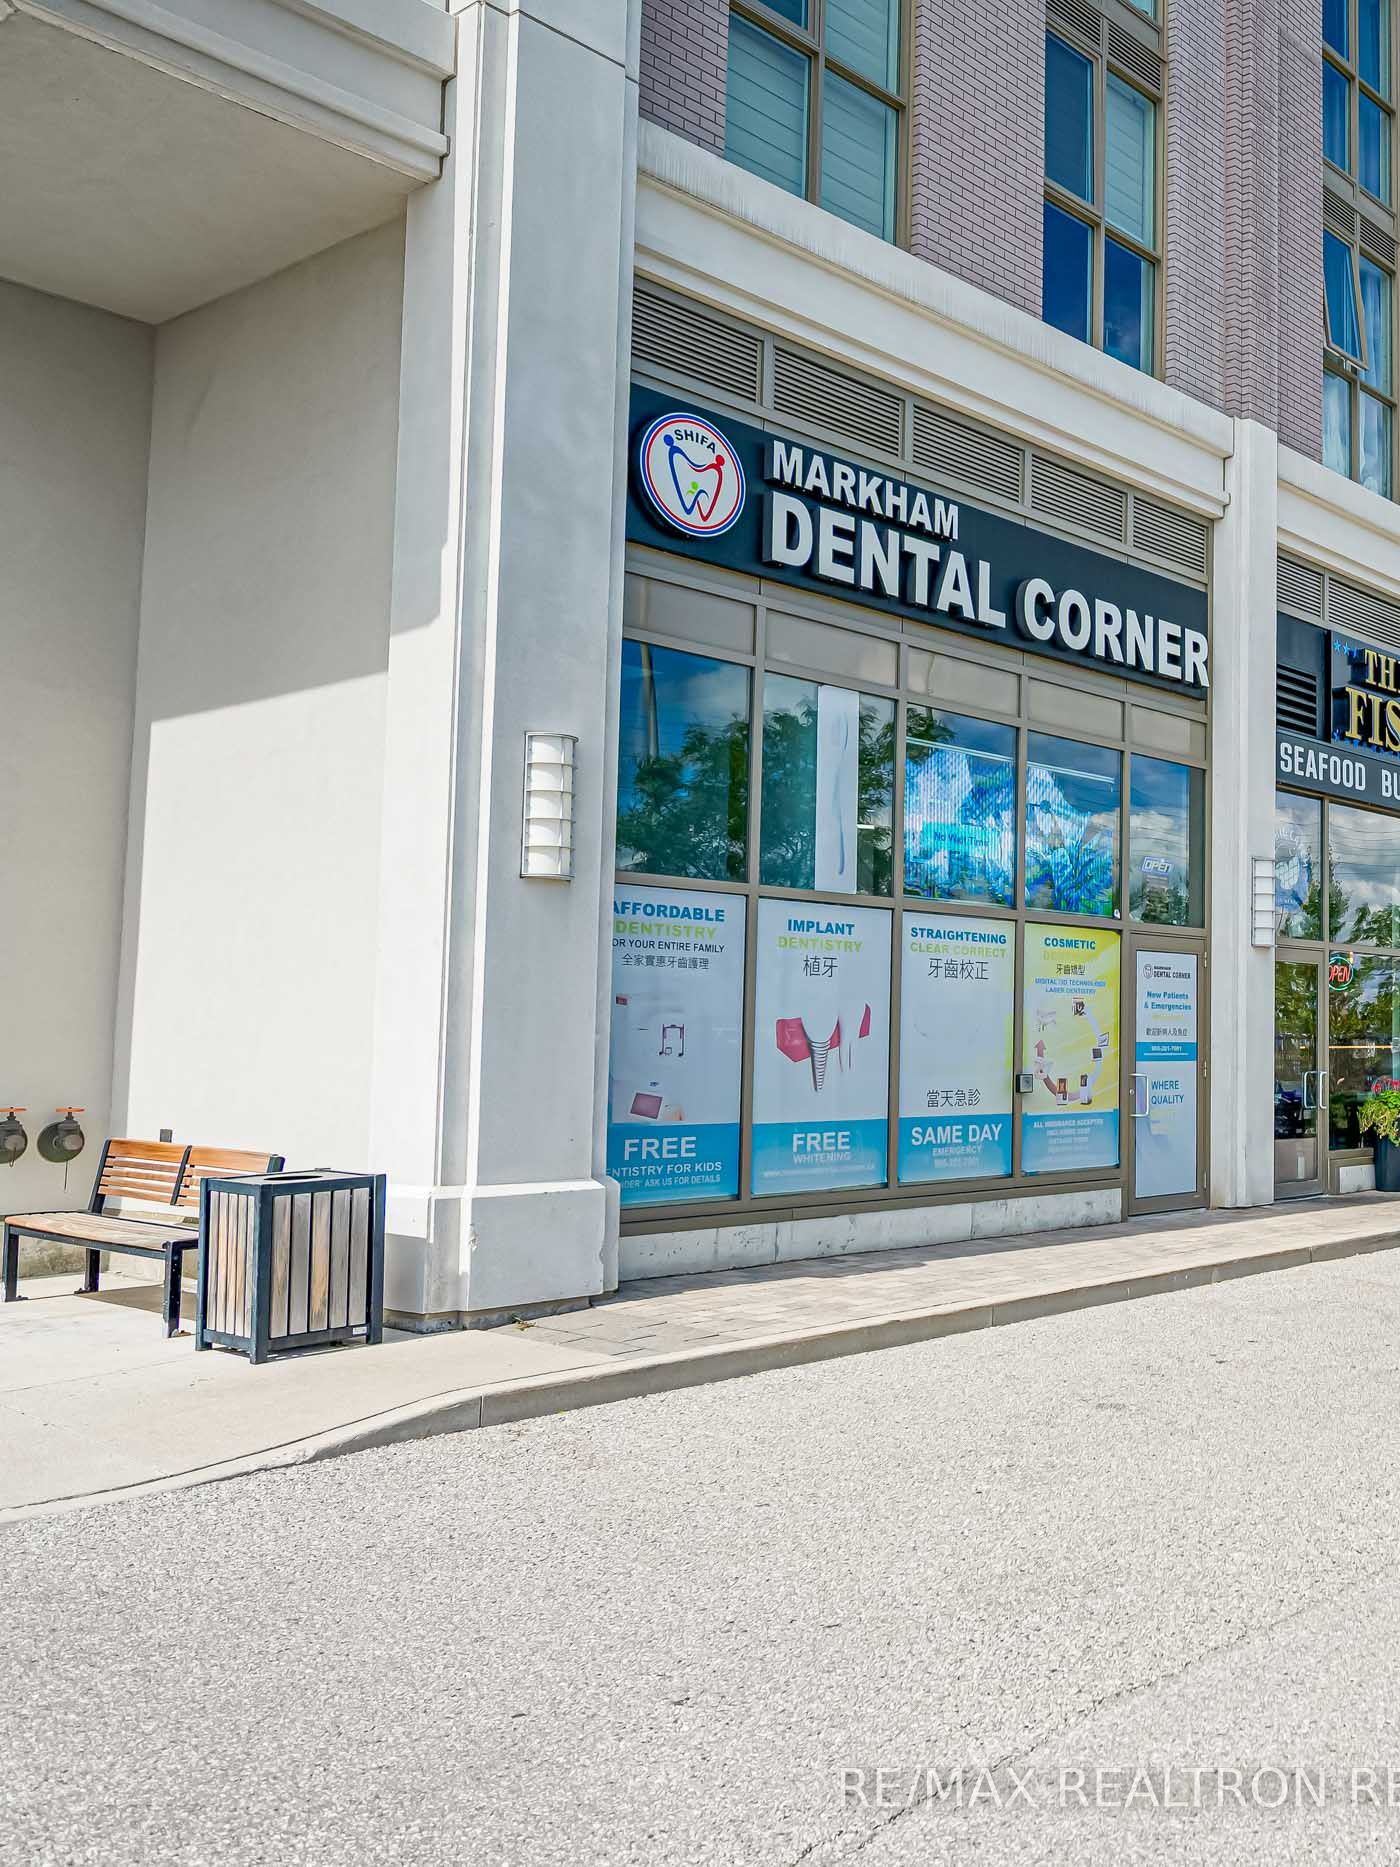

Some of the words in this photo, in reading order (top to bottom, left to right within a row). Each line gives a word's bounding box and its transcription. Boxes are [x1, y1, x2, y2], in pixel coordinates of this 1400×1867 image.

[674, 429, 716, 454] SHIFA
[771, 441, 959, 541] MARKHAM
[770, 491, 1006, 629] DENTAL
[1021, 577, 1209, 688] CORNER
[1279, 741, 1367, 792] SEAFOOD
[614, 901, 725, 922] AFFORDABLE
[615, 920, 718, 939] DENTISTRY
[787, 919, 855, 936] IMPLANT
[911, 927, 1007, 944] STRAIGHTENING
[612, 938, 626, 948] OR
[629, 939, 656, 949] YOUR
[657, 940, 691, 952] ENTIRE
[693, 943, 725, 953] FAMILY
[778, 936, 863, 952] DENTISTRY
[910, 942, 949, 954] CLEAR
[953, 945, 1007, 958] CORRECT
[1044, 937, 1096, 950] COSMETIC
[802, 955, 839, 978] 植牙
[928, 957, 990, 980] 牙齒校正
[1153, 970, 1172, 979] DENTAL
[1146, 991, 1162, 999] New
[1163, 991, 1189, 1000] Patients
[1151, 1002, 1192, 1011] Emergencies
[1151, 1081, 1180, 1091] WHERE
[926, 1088, 981, 1108] 當天急診
[1151, 1095, 1185, 1105] QUALITY
[792, 1131, 851, 1153] FREE
[911, 1125, 963, 1146] SAME
[968, 1122, 1002, 1143] DAY
[624, 1136, 697, 1161] FREE
[793, 1152, 851, 1164] WHITENING
[605, 1164, 664, 1177] ENTISTRY
[666, 1162, 692, 1175] FOR
[694, 1161, 722, 1173] KIDS
[644, 1178, 661, 1188] ASK
[662, 1177, 673, 1186] US
[674, 1176, 690, 1185] FOR
[691, 1174, 721, 1184] DETAILS
